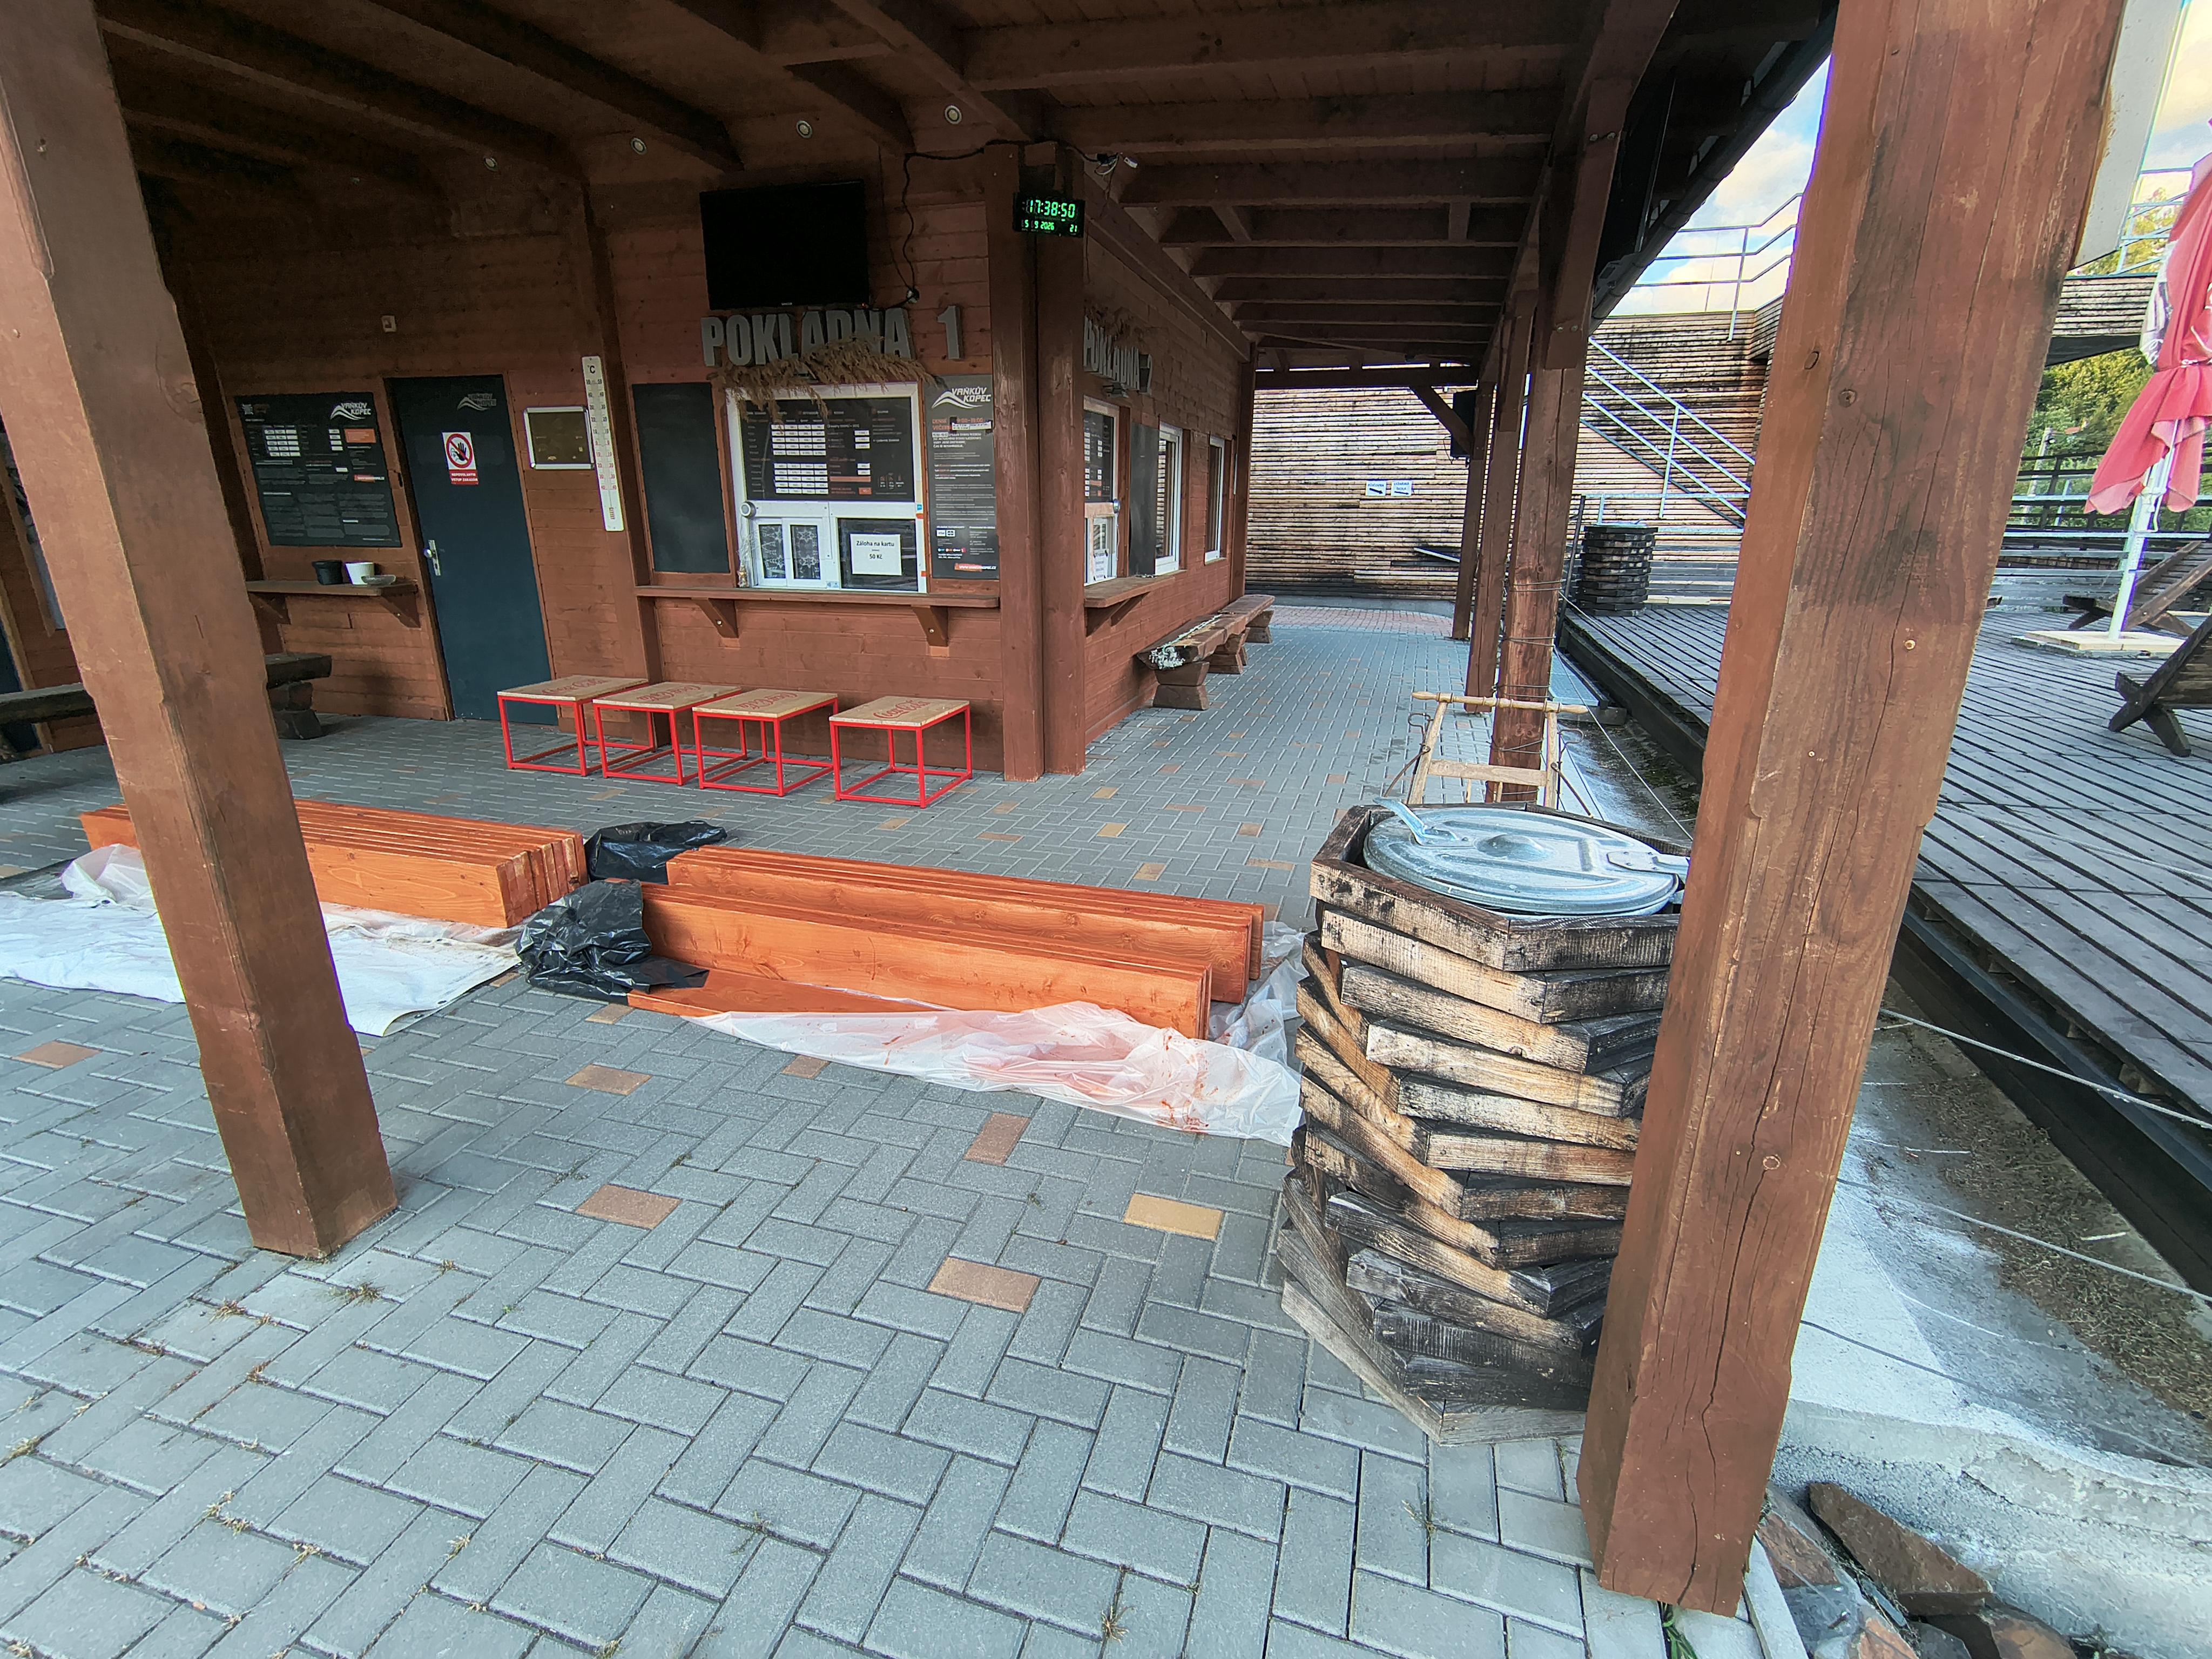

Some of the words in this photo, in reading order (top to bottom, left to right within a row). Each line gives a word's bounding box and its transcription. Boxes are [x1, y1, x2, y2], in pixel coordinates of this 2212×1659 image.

[1029, 200, 1076, 218] 17:38:50
[937, 306, 959, 360] 1
[952, 386, 987, 395] VAŇKŮV
[963, 394, 992, 402] KOPEC
